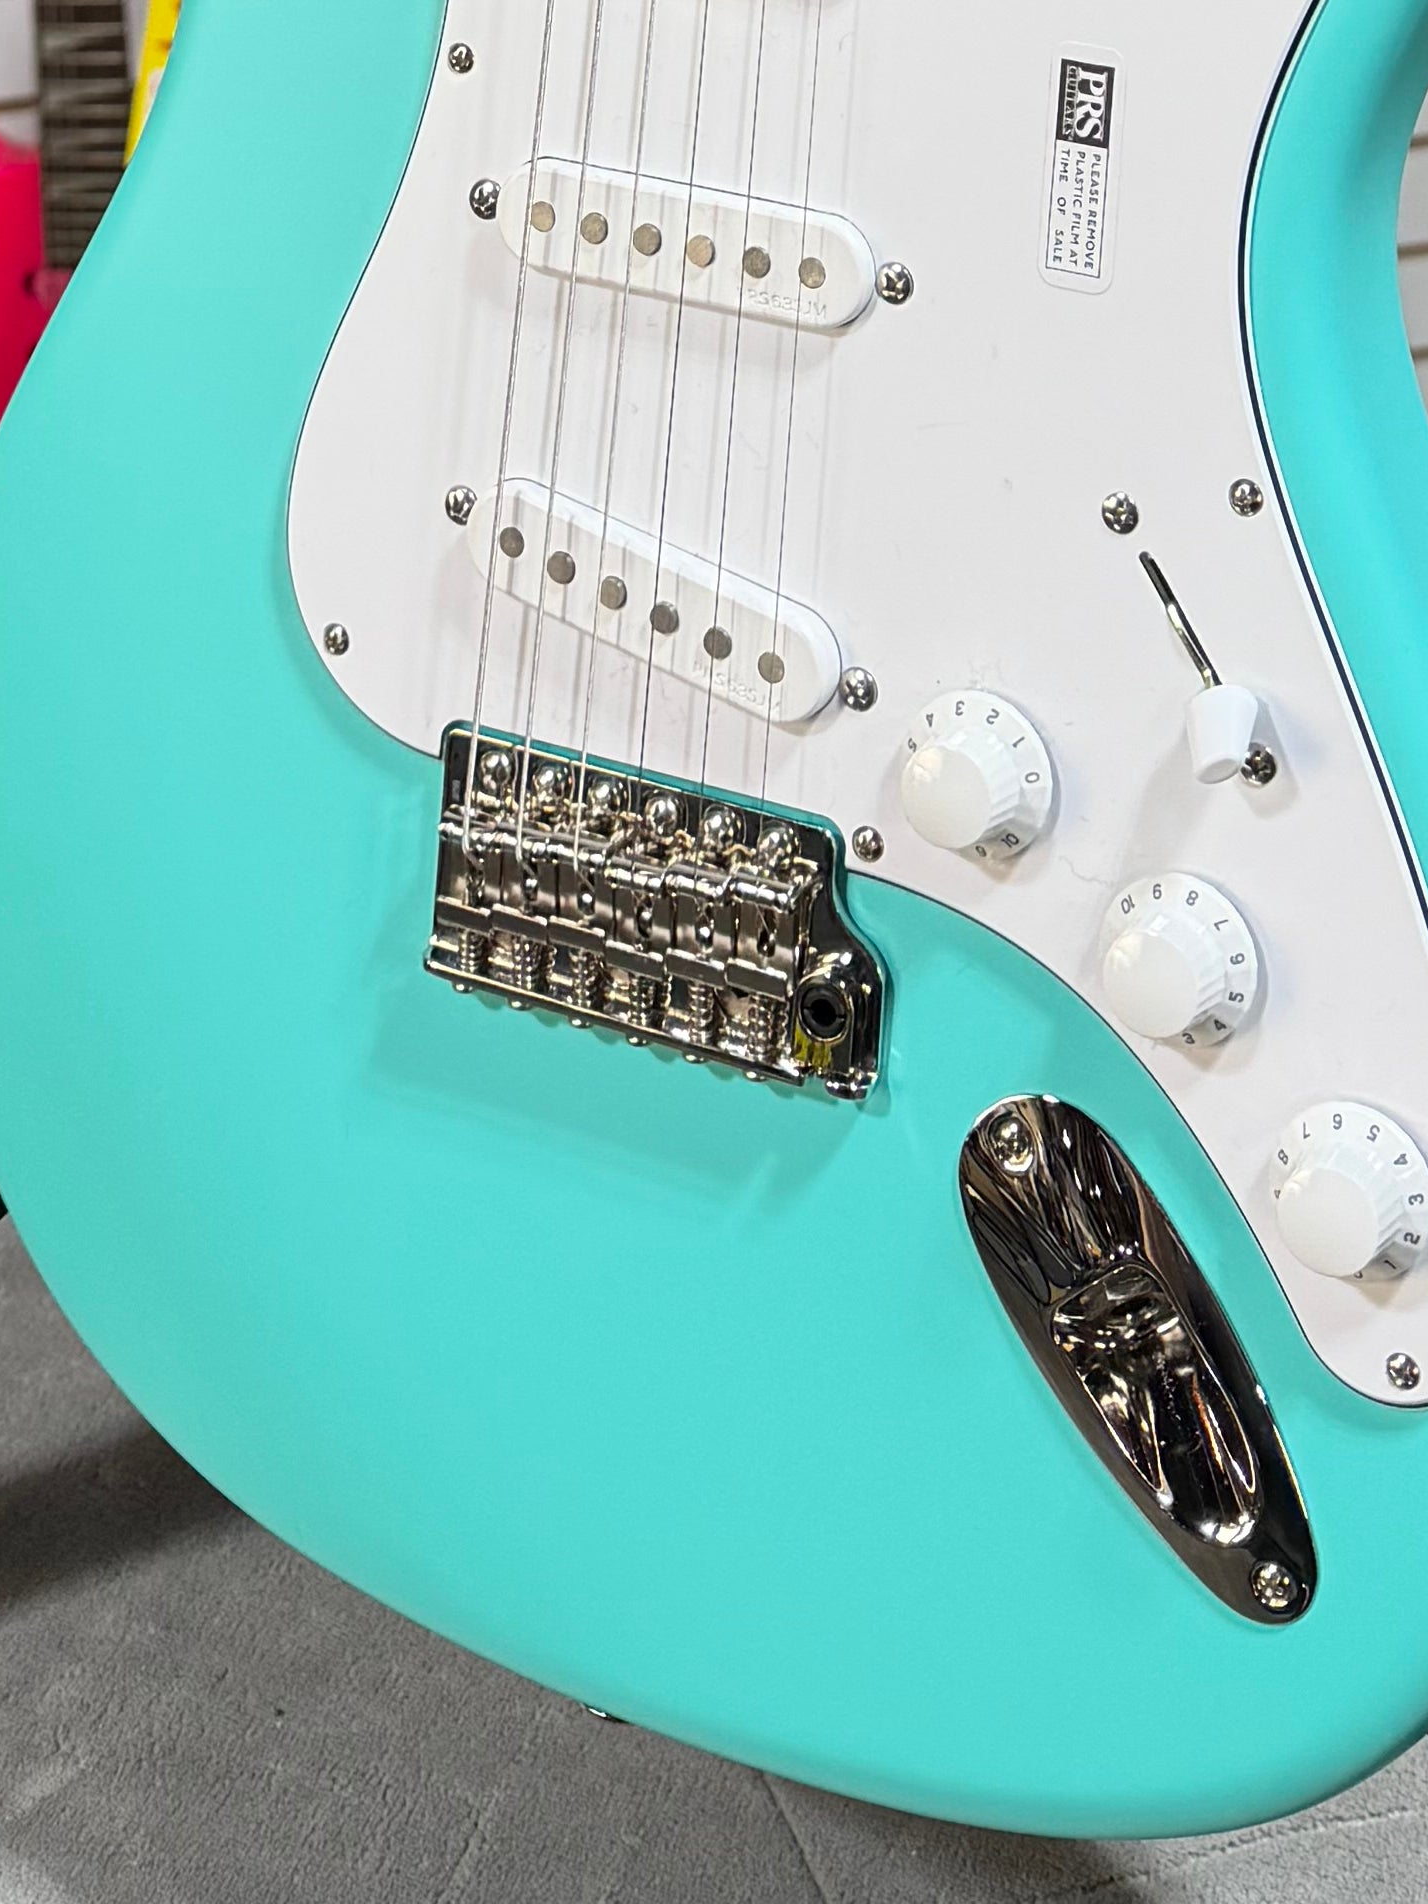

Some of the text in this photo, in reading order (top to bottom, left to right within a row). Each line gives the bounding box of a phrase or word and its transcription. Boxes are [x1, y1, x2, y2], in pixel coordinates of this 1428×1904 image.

[1074, 65, 1109, 143] PRS
[1052, 148, 1071, 265] TIME OF SALE
[1068, 150, 1086, 267] PLASTIC FILM AT
[1083, 153, 1102, 270] PLEASE REMOVE
[955, 700, 966, 716] 3
[925, 712, 935, 728] 4
[986, 708, 1000, 725] 2
[1012, 735, 1025, 749] 1
[1025, 771, 1040, 784] 0
[1001, 832, 1020, 849] 10
[1120, 893, 1136, 915] 10
[1185, 890, 1199, 906] 8
[1213, 918, 1229, 932] 7
[1230, 952, 1246, 966] 6
[1228, 990, 1245, 1003] 5
[1213, 1018, 1228, 1032] 4
[1332, 1113, 1343, 1130] 6
[1301, 1121, 1311, 1139] 7
[1366, 1124, 1381, 1143] 5
[1277, 1148, 1289, 1166] 8
[1393, 1152, 1409, 1167] 4
[1408, 1192, 1425, 1207] 3
[1403, 1231, 1421, 1246] 2
